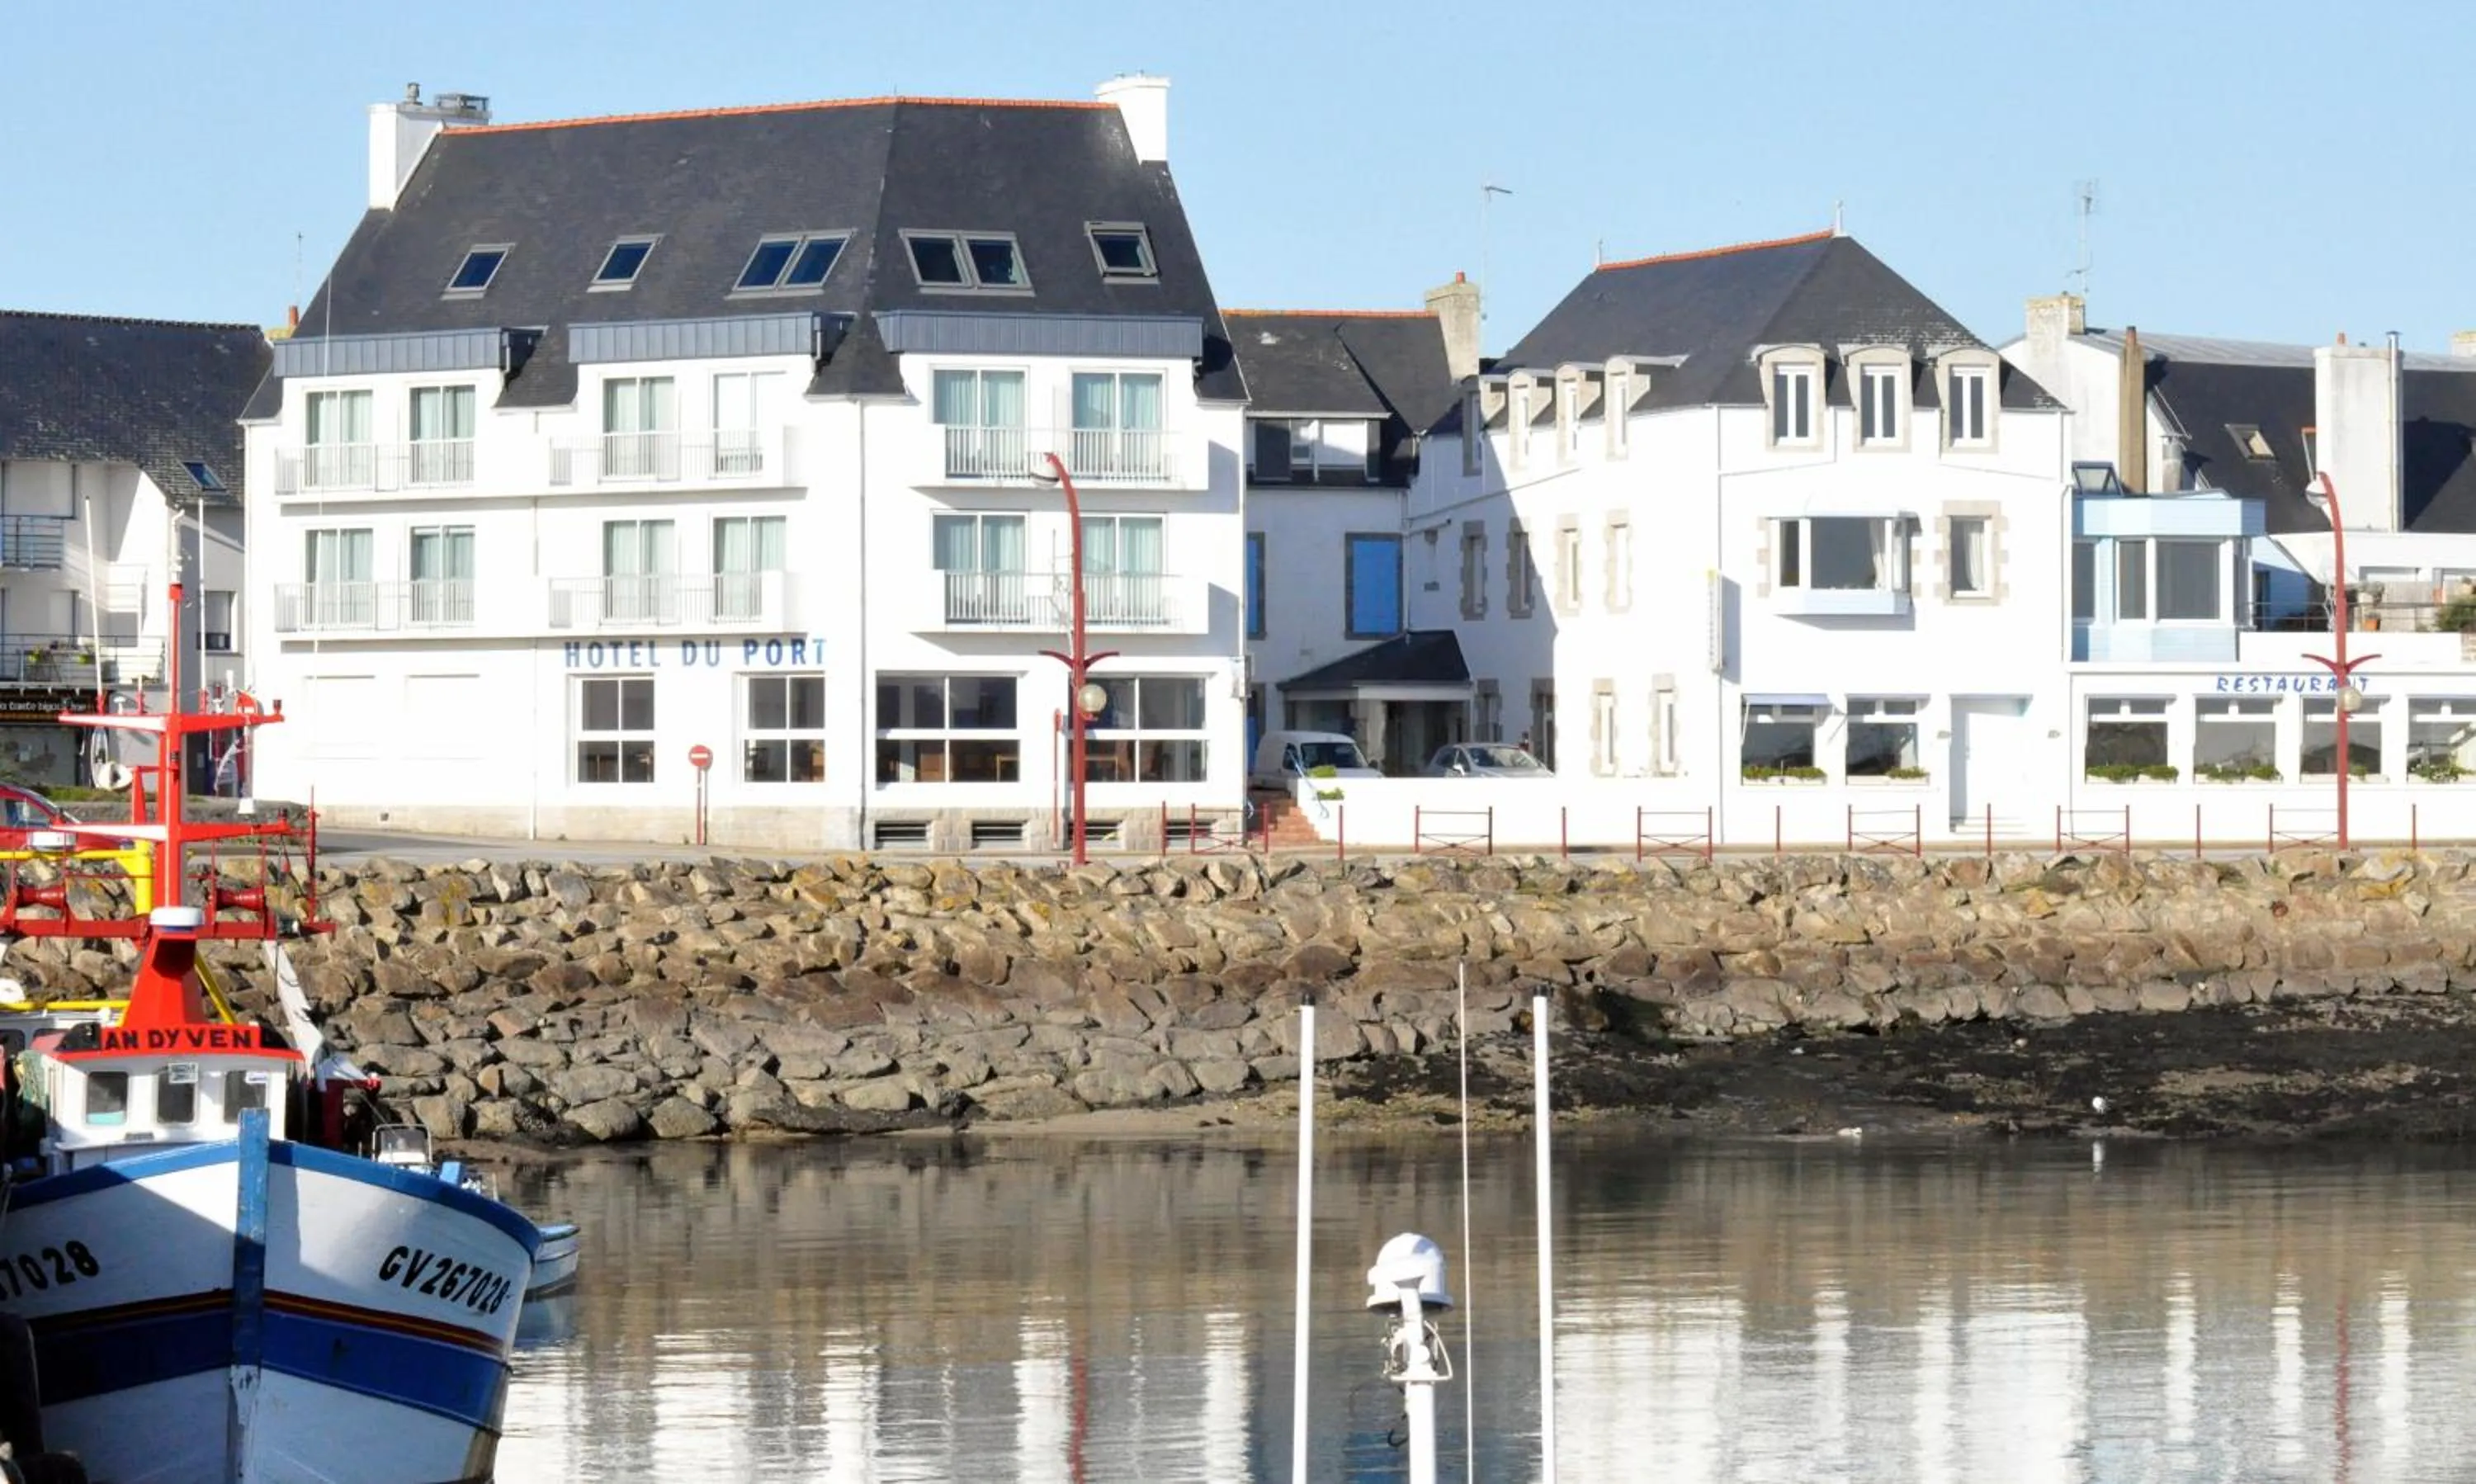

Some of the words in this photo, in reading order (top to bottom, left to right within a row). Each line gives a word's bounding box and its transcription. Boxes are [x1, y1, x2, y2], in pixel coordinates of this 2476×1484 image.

[564, 640, 661, 669] HOTEL
[681, 640, 721, 667] DU
[743, 638, 827, 666] PORT
[0, 1240, 100, 1302] 7028
